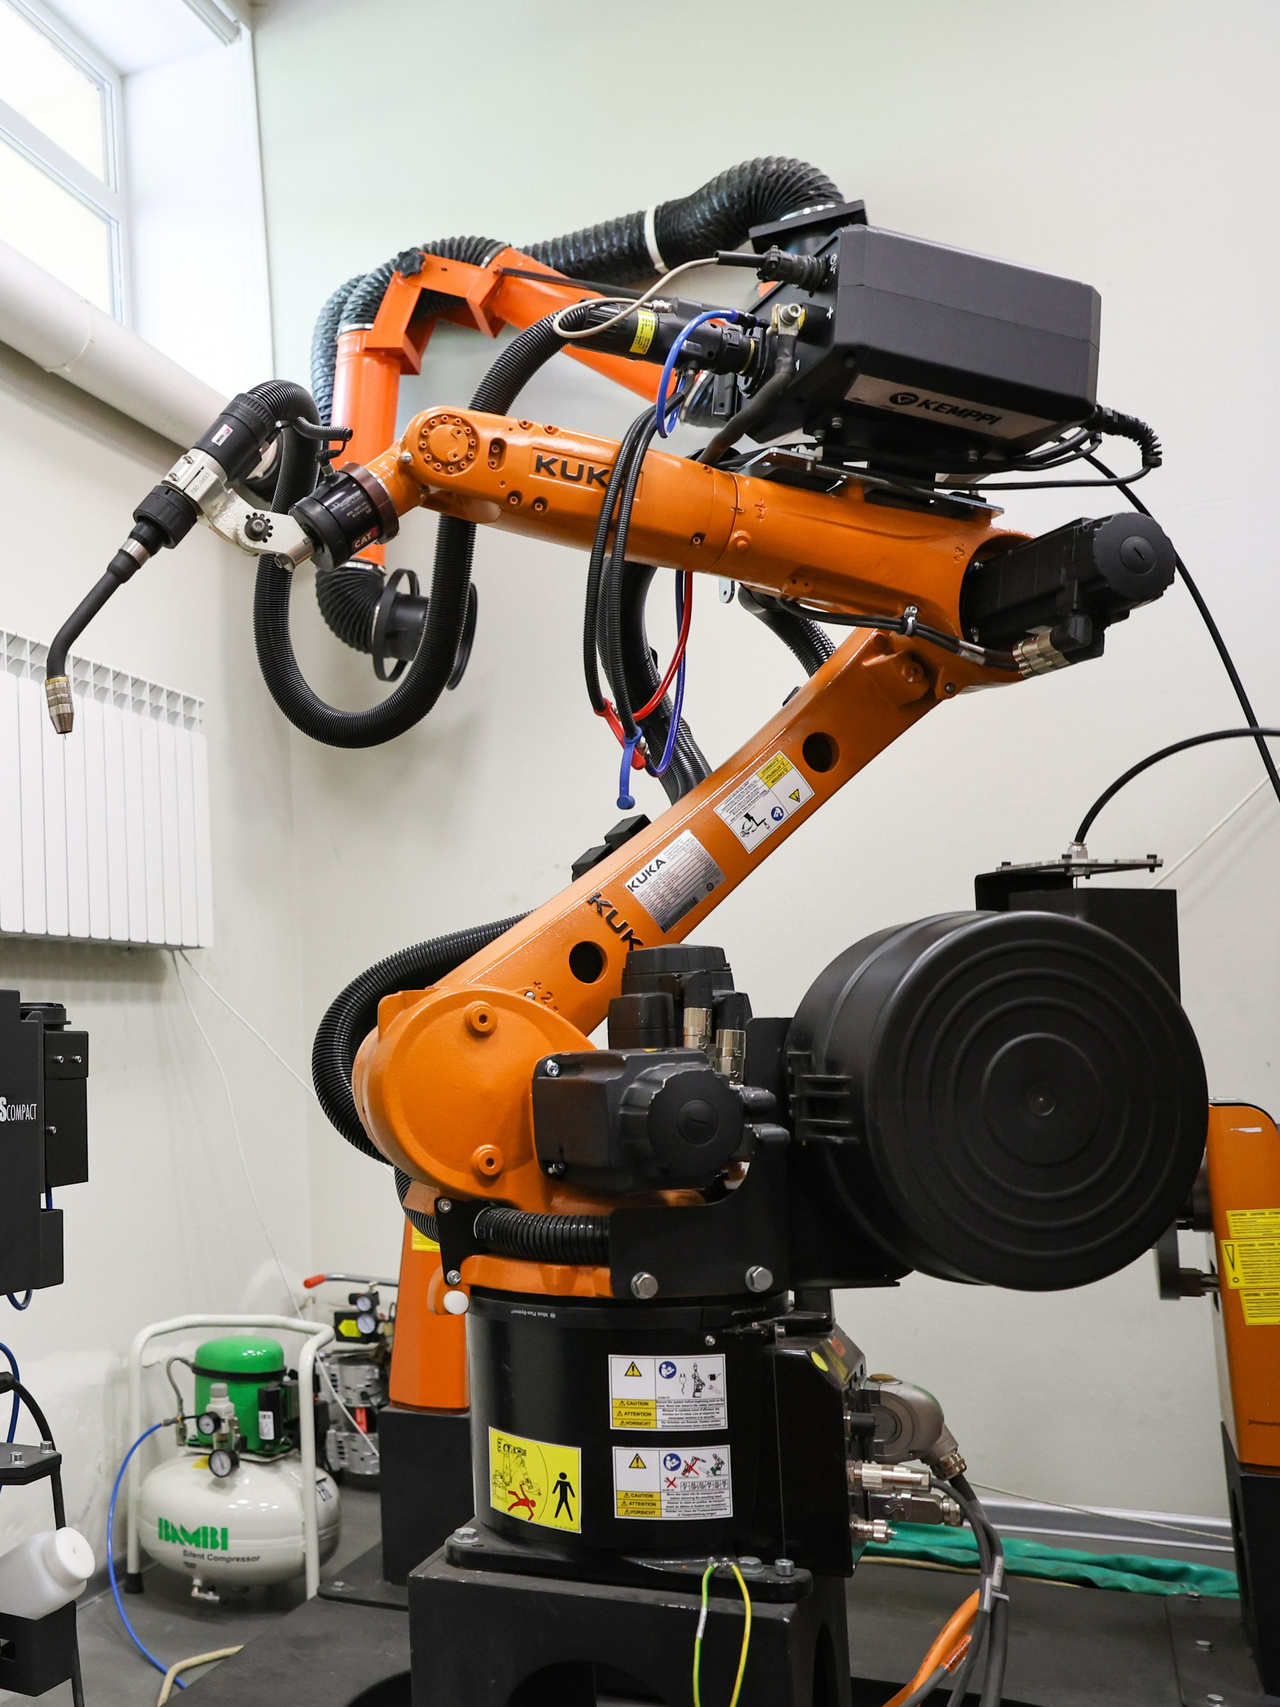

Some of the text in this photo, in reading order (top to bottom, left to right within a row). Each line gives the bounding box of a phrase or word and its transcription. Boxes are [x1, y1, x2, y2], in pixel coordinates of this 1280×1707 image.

[917, 399, 1003, 426] KEMPPI
[535, 453, 610, 488] KUK
[354, 531, 372, 548] CAT
[627, 859, 667, 892] KUKA
[587, 891, 644, 952] KUK
[158, 1517, 228, 1551] BAMBI
[183, 1549, 261, 1564] Silent Compressor
